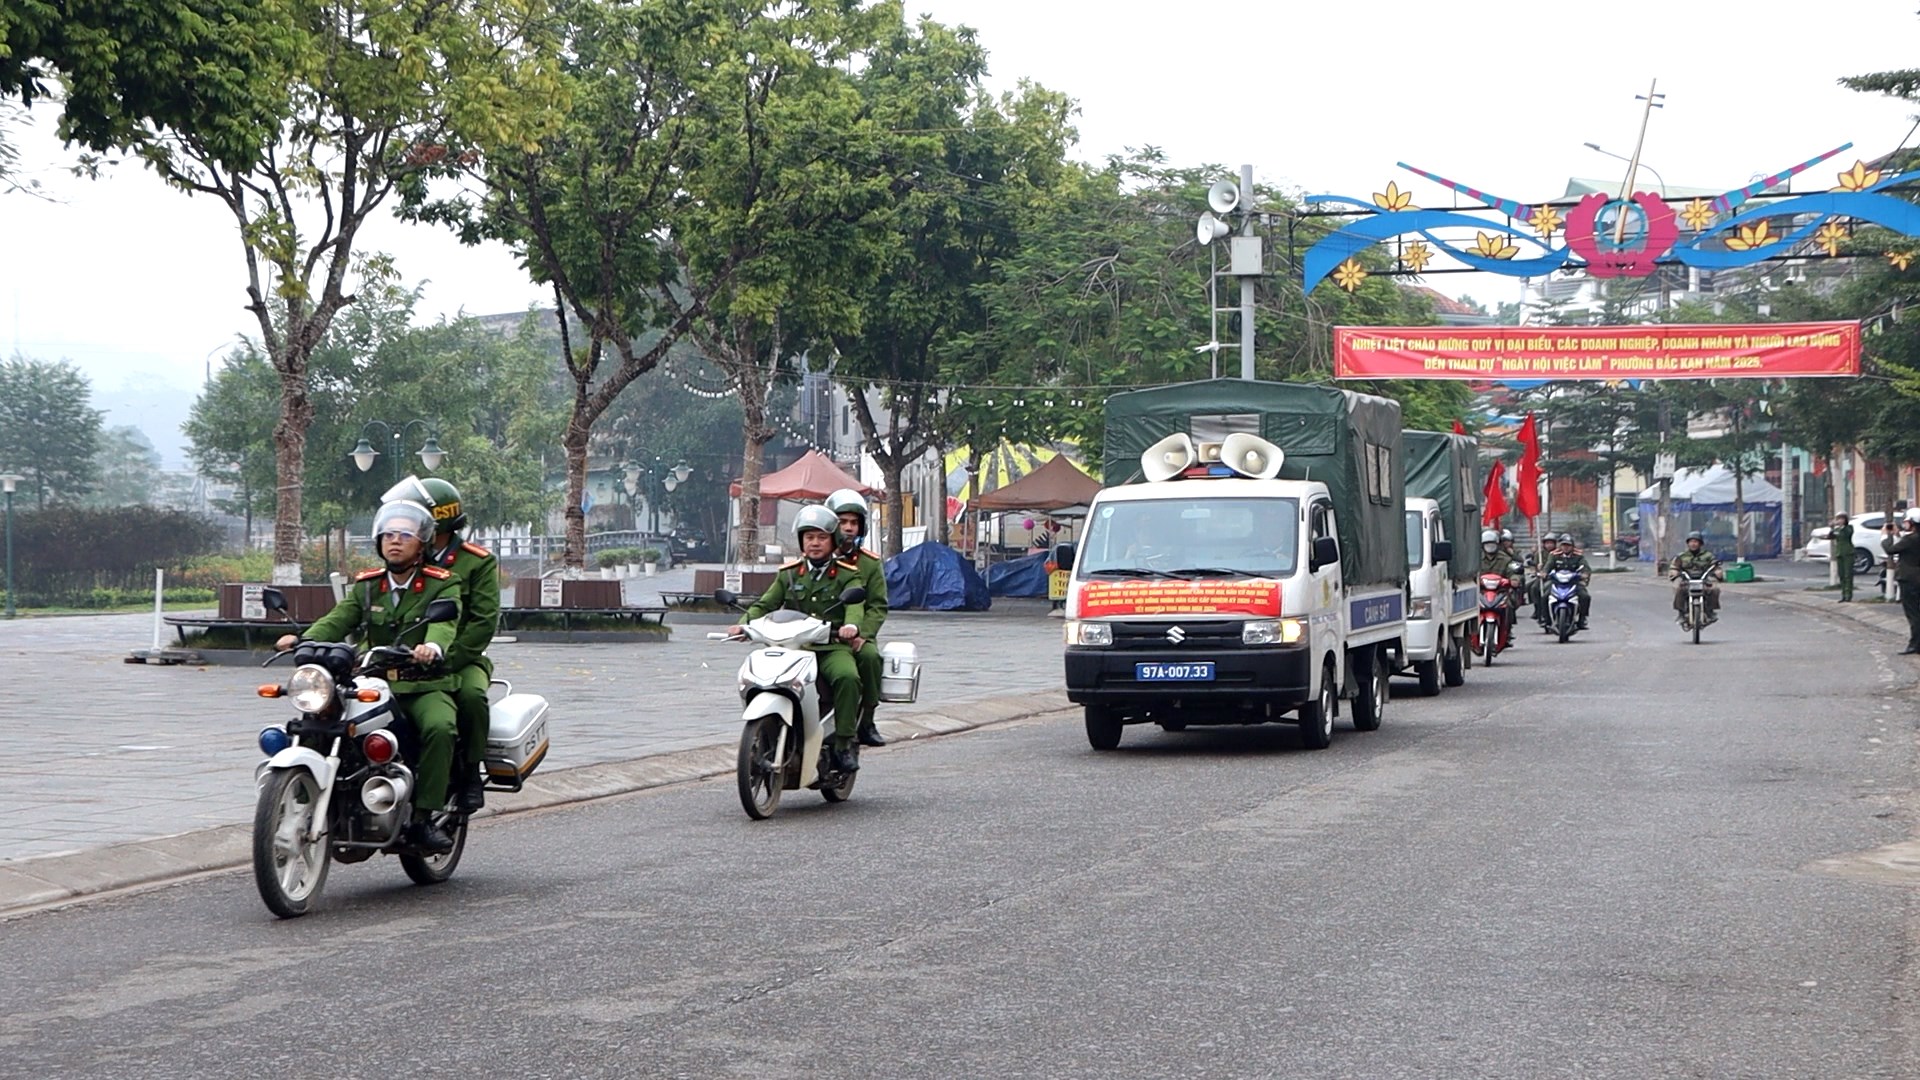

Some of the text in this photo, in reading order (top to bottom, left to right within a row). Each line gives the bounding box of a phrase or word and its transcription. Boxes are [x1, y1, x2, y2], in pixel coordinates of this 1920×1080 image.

[1352, 337, 1381, 352] NHIỆT
[1384, 337, 1405, 352] LIỆT
[1408, 337, 1435, 351] CHÀO
[1494, 339, 1504, 353] VỊ
[1507, 339, 1525, 353] ĐẠI
[1557, 336, 1578, 350] CÁC
[1581, 338, 1617, 350] DOANH
[1619, 336, 1660, 352] NGHIỆP,
[1662, 337, 1699, 349] DOANH
[1701, 335, 1732, 349] NHÂN
[1734, 334, 1749, 349] VÀ
[1751, 333, 1785, 348] NGƯỜI
[1810, 333, 1841, 349] ĐỘNG
[1424, 355, 1445, 370] ĐẾN
[1448, 358, 1477, 370] THAM
[1479, 357, 1495, 373] DỰ
[1532, 356, 1550, 373] HỘI
[1552, 356, 1576, 373] VIỆC
[1610, 355, 1653, 370] PHƯỜNG
[1655, 353, 1678, 369] BẮC
[1733, 357, 1763, 369] 2025.
[433, 502, 460, 520] CSTT
[525, 720, 546, 756] CSTT
